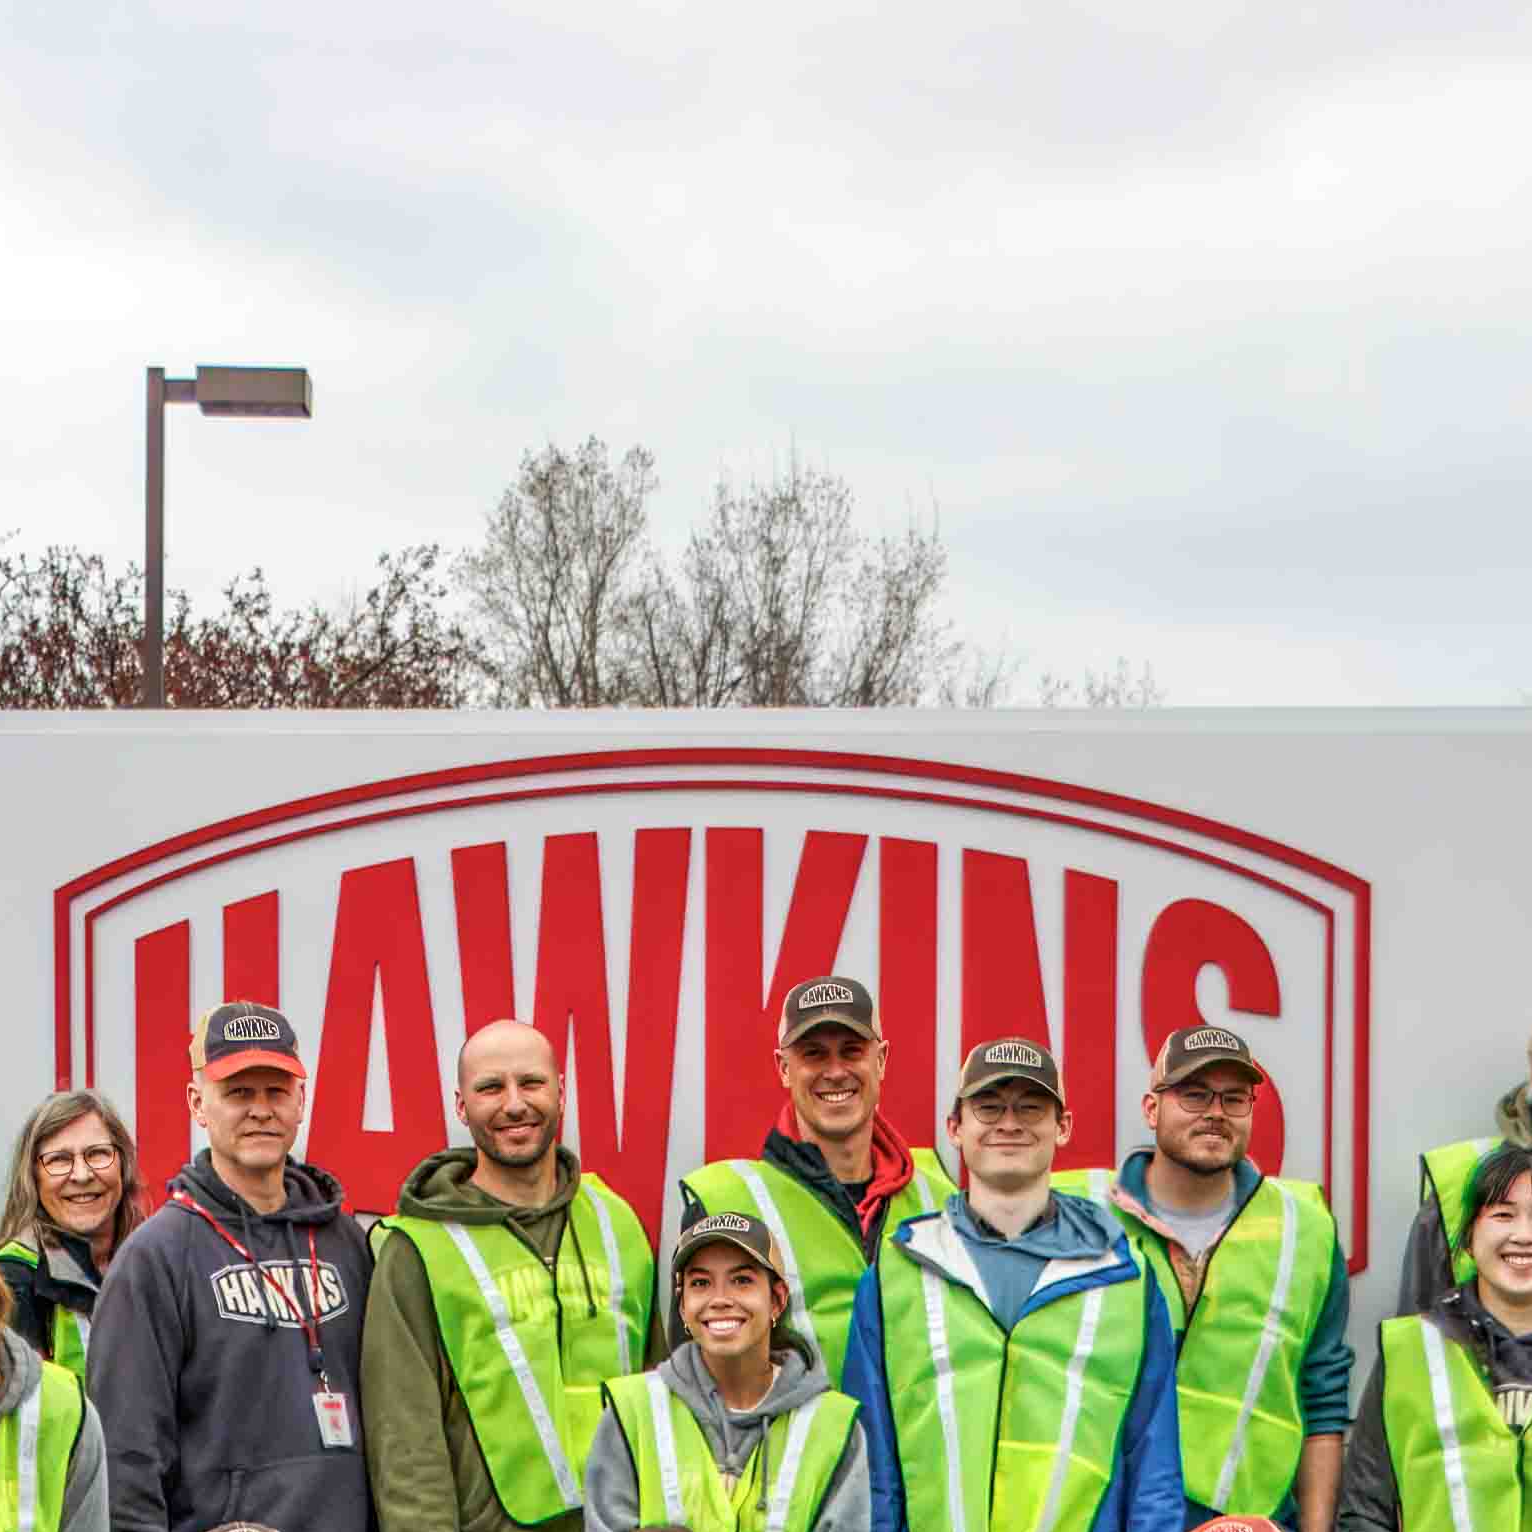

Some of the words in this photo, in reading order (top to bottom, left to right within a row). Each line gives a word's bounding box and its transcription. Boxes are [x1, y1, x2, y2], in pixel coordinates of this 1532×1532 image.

[799, 985, 852, 1006] HAWKINS
[226, 1018, 277, 1038] HAWKINS
[986, 1044, 1041, 1066] HAWKINS
